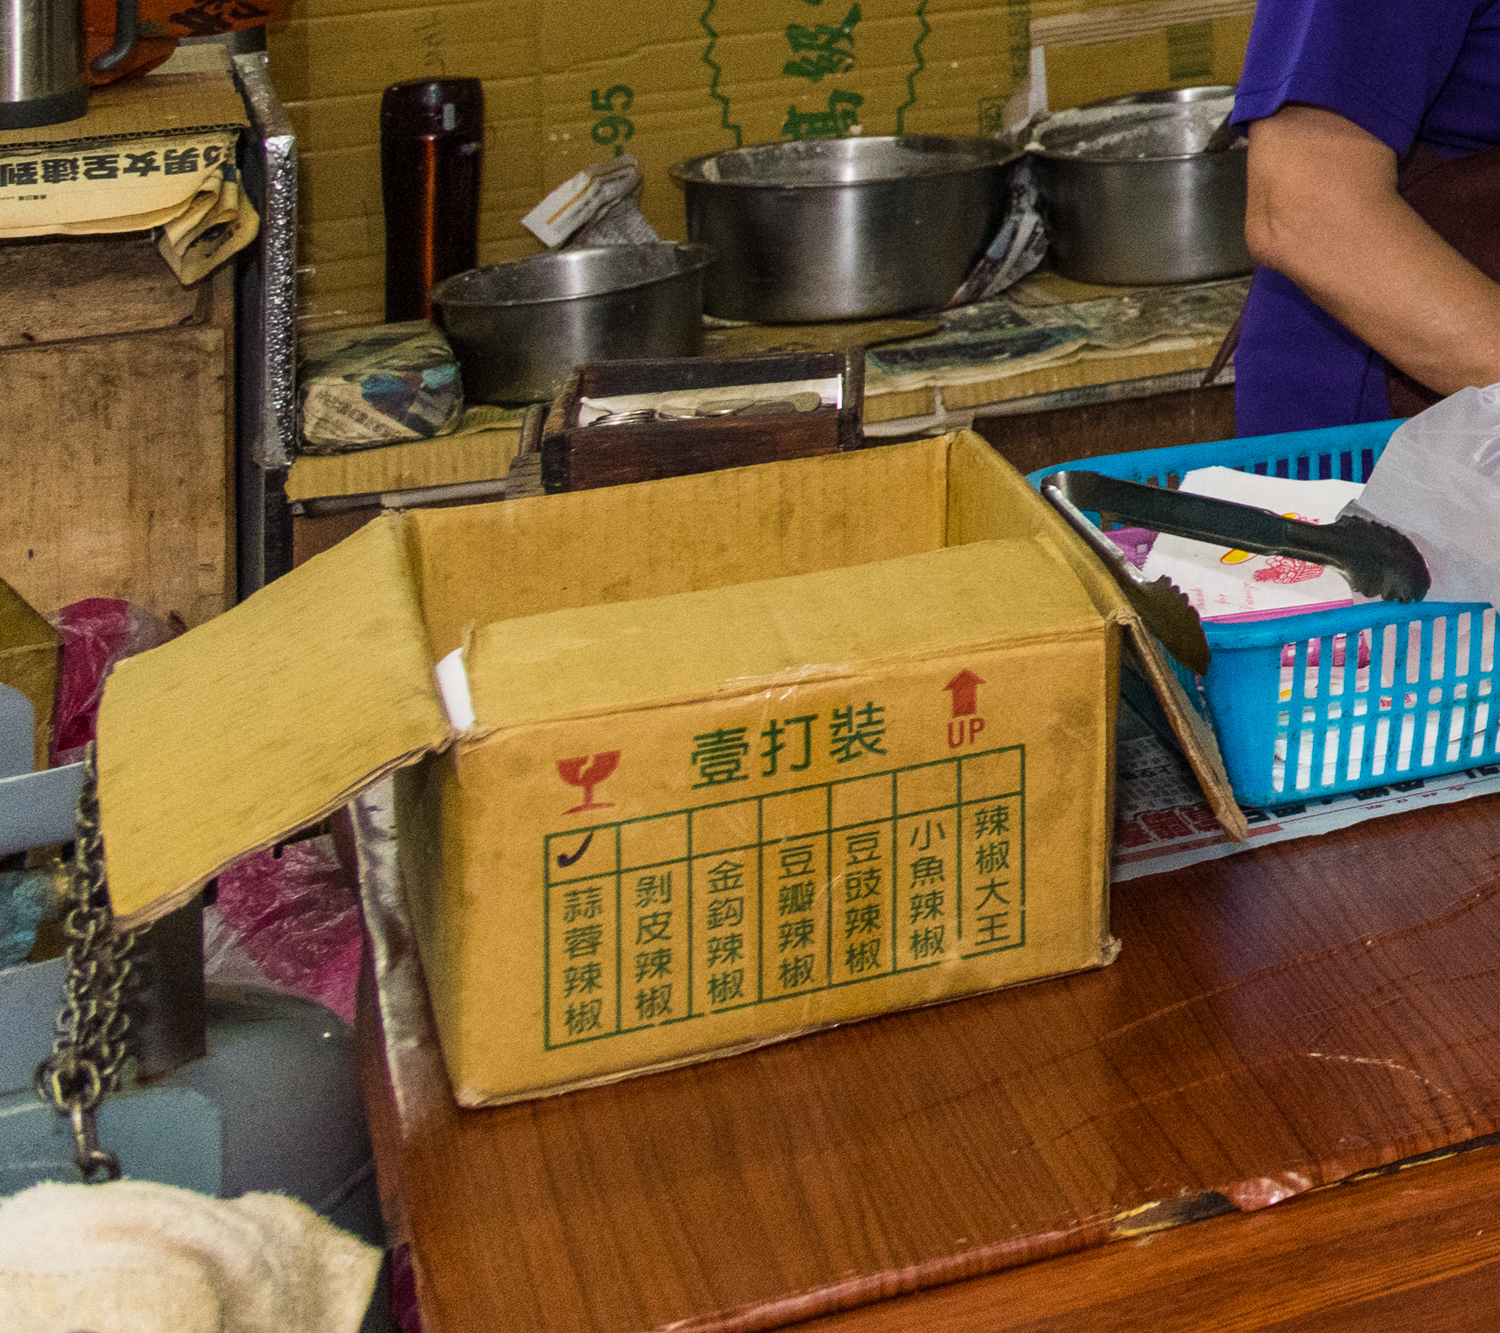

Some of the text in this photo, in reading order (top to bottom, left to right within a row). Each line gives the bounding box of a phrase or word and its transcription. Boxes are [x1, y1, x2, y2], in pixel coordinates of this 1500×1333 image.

[691, 703, 889, 790] 壹打裝
[947, 715, 986, 749] UP
[634, 870, 674, 1021] 剝皮辣椒
[778, 841, 815, 990] 豆瓣辣椒
[844, 828, 881, 975] 豆豉辣椒
[908, 817, 946, 961] 小魚辣椒
[974, 805, 1011, 947] 辣椒大王
[563, 885, 604, 1037] 蒜蓉辣椒
